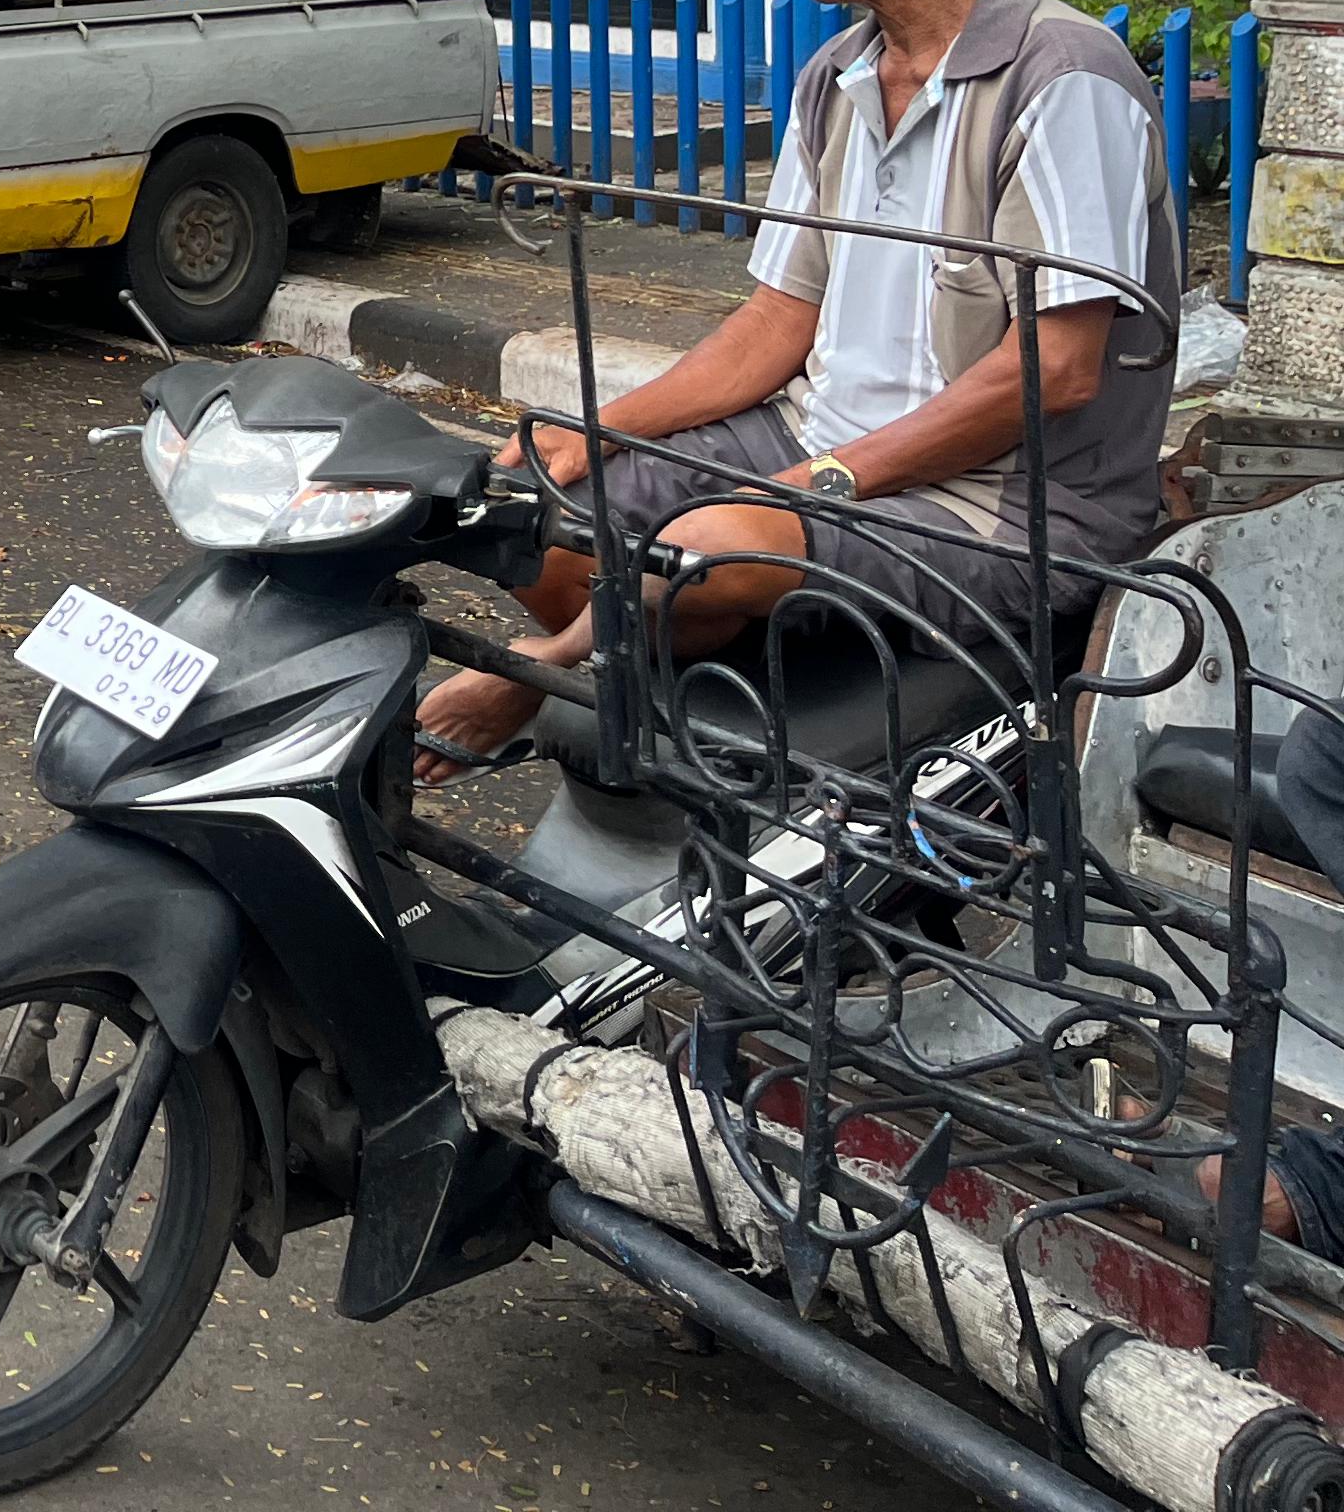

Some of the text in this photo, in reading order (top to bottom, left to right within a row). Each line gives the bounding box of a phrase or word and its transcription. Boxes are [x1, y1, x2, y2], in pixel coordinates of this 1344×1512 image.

[44, 594, 206, 696] BL 3369 MD
[623, 972, 665, 1003] RIDING
